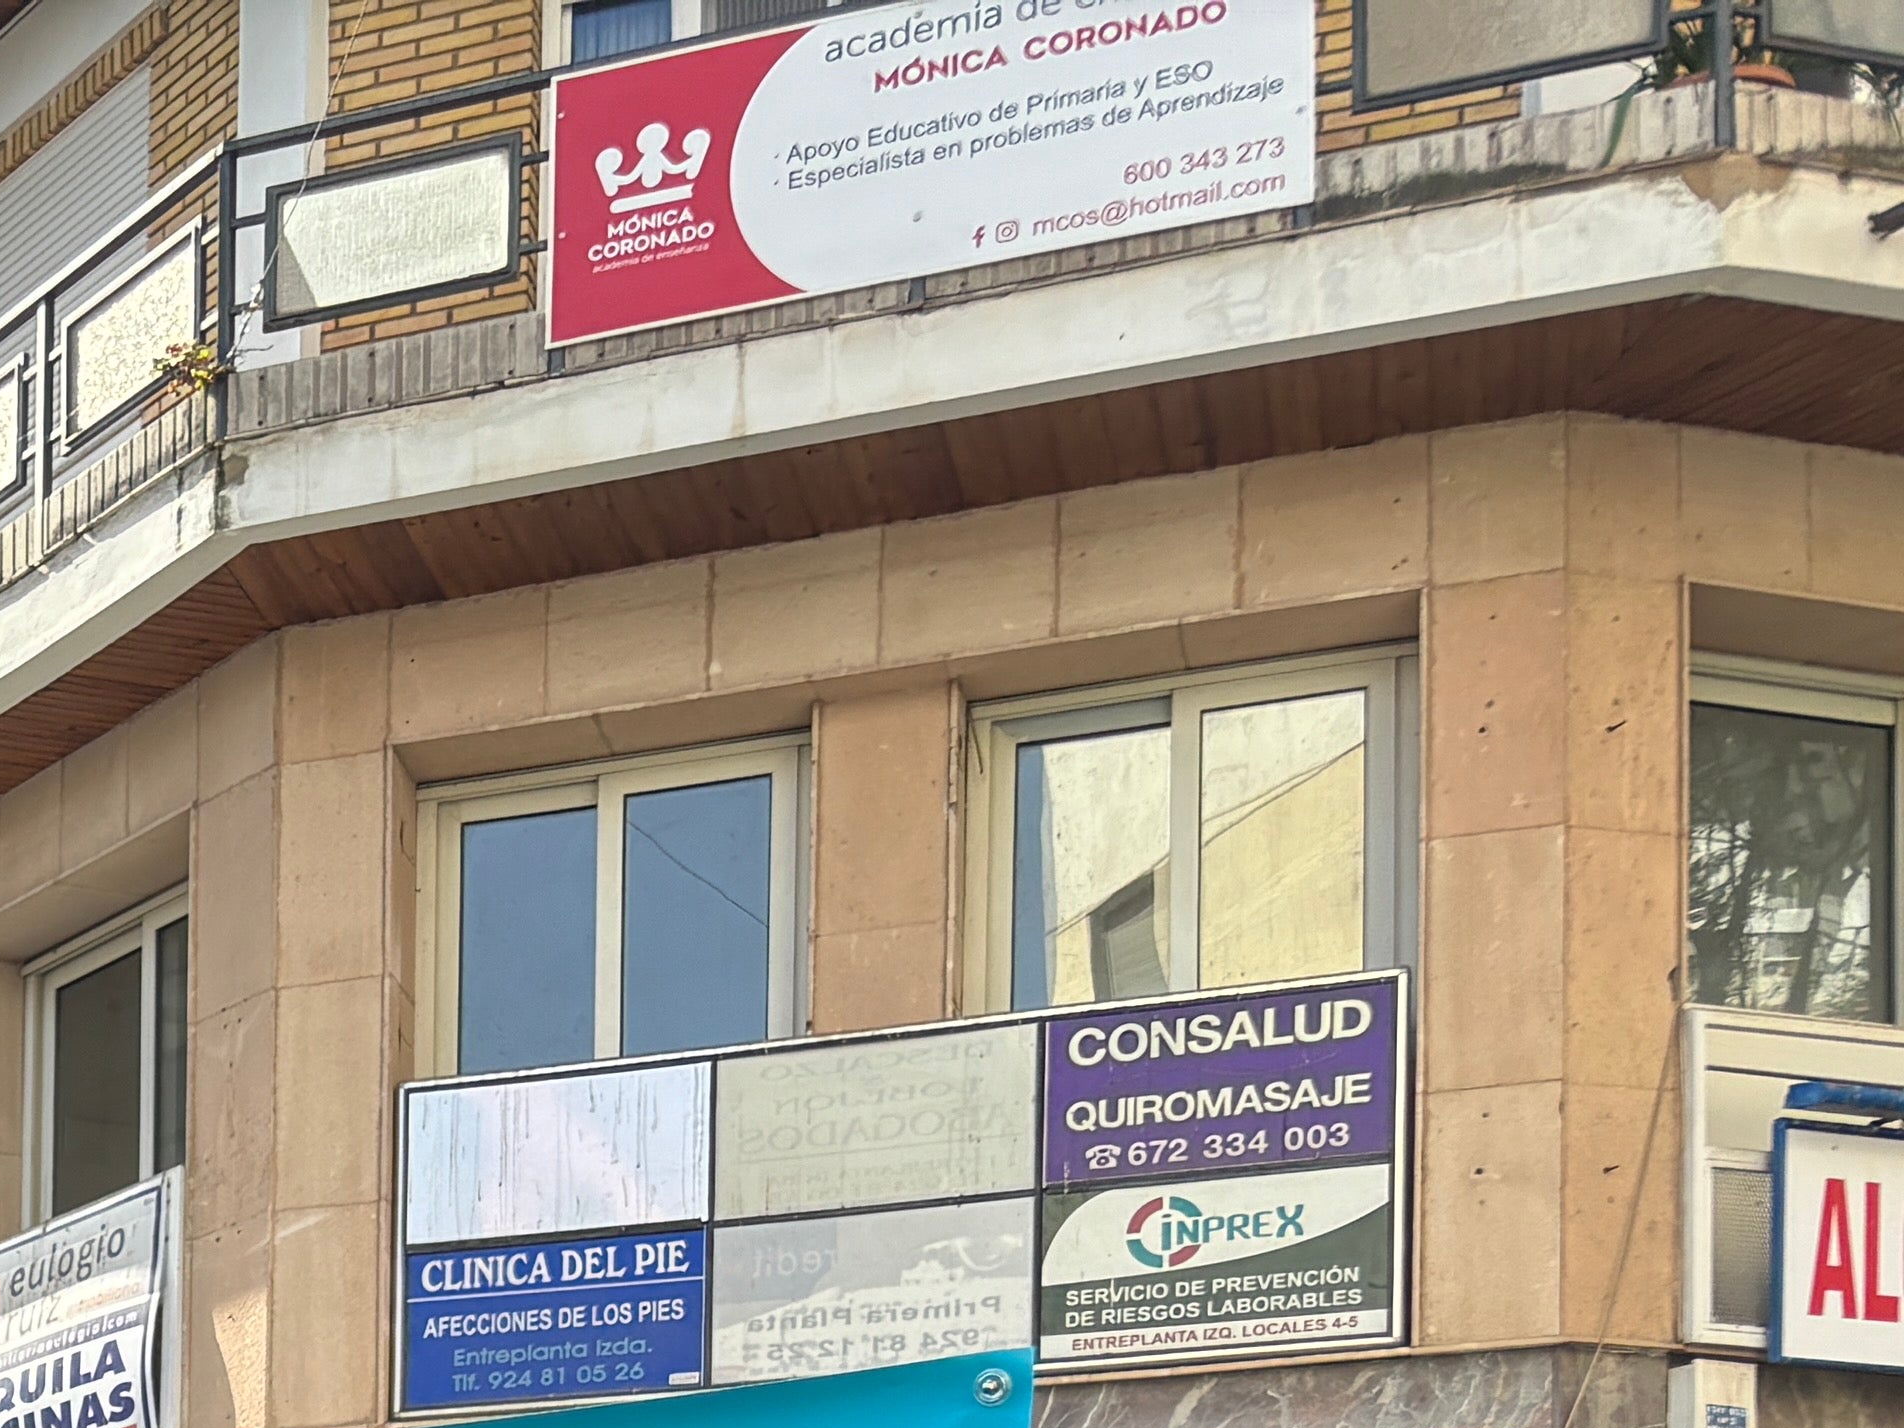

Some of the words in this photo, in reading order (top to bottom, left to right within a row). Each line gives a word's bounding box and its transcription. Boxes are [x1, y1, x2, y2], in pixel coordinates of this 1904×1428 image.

[824, 0, 1002, 63] academia
[874, 44, 1009, 93] MÓNICA
[1023, 0, 1227, 60] CORONADO
[785, 134, 860, 165] Apoyo
[867, 110, 982, 148] Educativo
[988, 100, 1019, 122] de
[1027, 77, 1127, 115] Primaria
[1133, 76, 1149, 99] y
[1154, 60, 1214, 90] ESO
[788, 147, 925, 190] Especialista
[933, 141, 962, 161] en
[969, 114, 1096, 158] problemas
[1101, 106, 1133, 127] de
[1137, 75, 1285, 122] Aprendizaje
[1122, 157, 1173, 185] 600
[1179, 146, 1228, 175] 343
[1235, 136, 1286, 165] 273
[607, 206, 694, 239] MÓNICA
[1032, 174, 1287, 236] mcos@hotmail.com
[587, 222, 715, 262] CORONADO
[1068, 999, 1372, 1066] CONSALUD
[1065, 1072, 1373, 1132] QUIROMASAJE
[1127, 1137, 1189, 1166] 672
[1203, 1130, 1269, 1159] 334
[1284, 1122, 1350, 1151] 003
[9, 1223, 125, 1297] eulogio
[421, 1252, 551, 1292] CLINICA
[561, 1246, 627, 1282] DEL
[634, 1240, 690, 1276] PIE
[1065, 1282, 1169, 1307] SERVICIO
[1175, 1279, 1206, 1297] DE
[1212, 1264, 1360, 1295] PREVENCIÓN
[1065, 1310, 1095, 1328] DE
[1101, 1302, 1200, 1325] RIESGOS
[1207, 1289, 1363, 1317] LABORABLES
[423, 1308, 552, 1339] AFECCIONES
[558, 1306, 587, 1329] DE
[592, 1302, 632, 1327] LOS
[638, 1298, 685, 1322] PIES
[1071, 1330, 1198, 1351] ENTREPLANTA
[1203, 1325, 1237, 1342] IZQ.
[1242, 1317, 1327, 1337] LOCALES
[1332, 1315, 1359, 1329] 4-5
[453, 1341, 588, 1368] Entreplanta
[596, 1337, 653, 1357] Izda.
[488, 1370, 532, 1390] 924
[540, 1367, 565, 1386] 81
[576, 1365, 607, 1384] 05
[615, 1362, 644, 1381] 26
